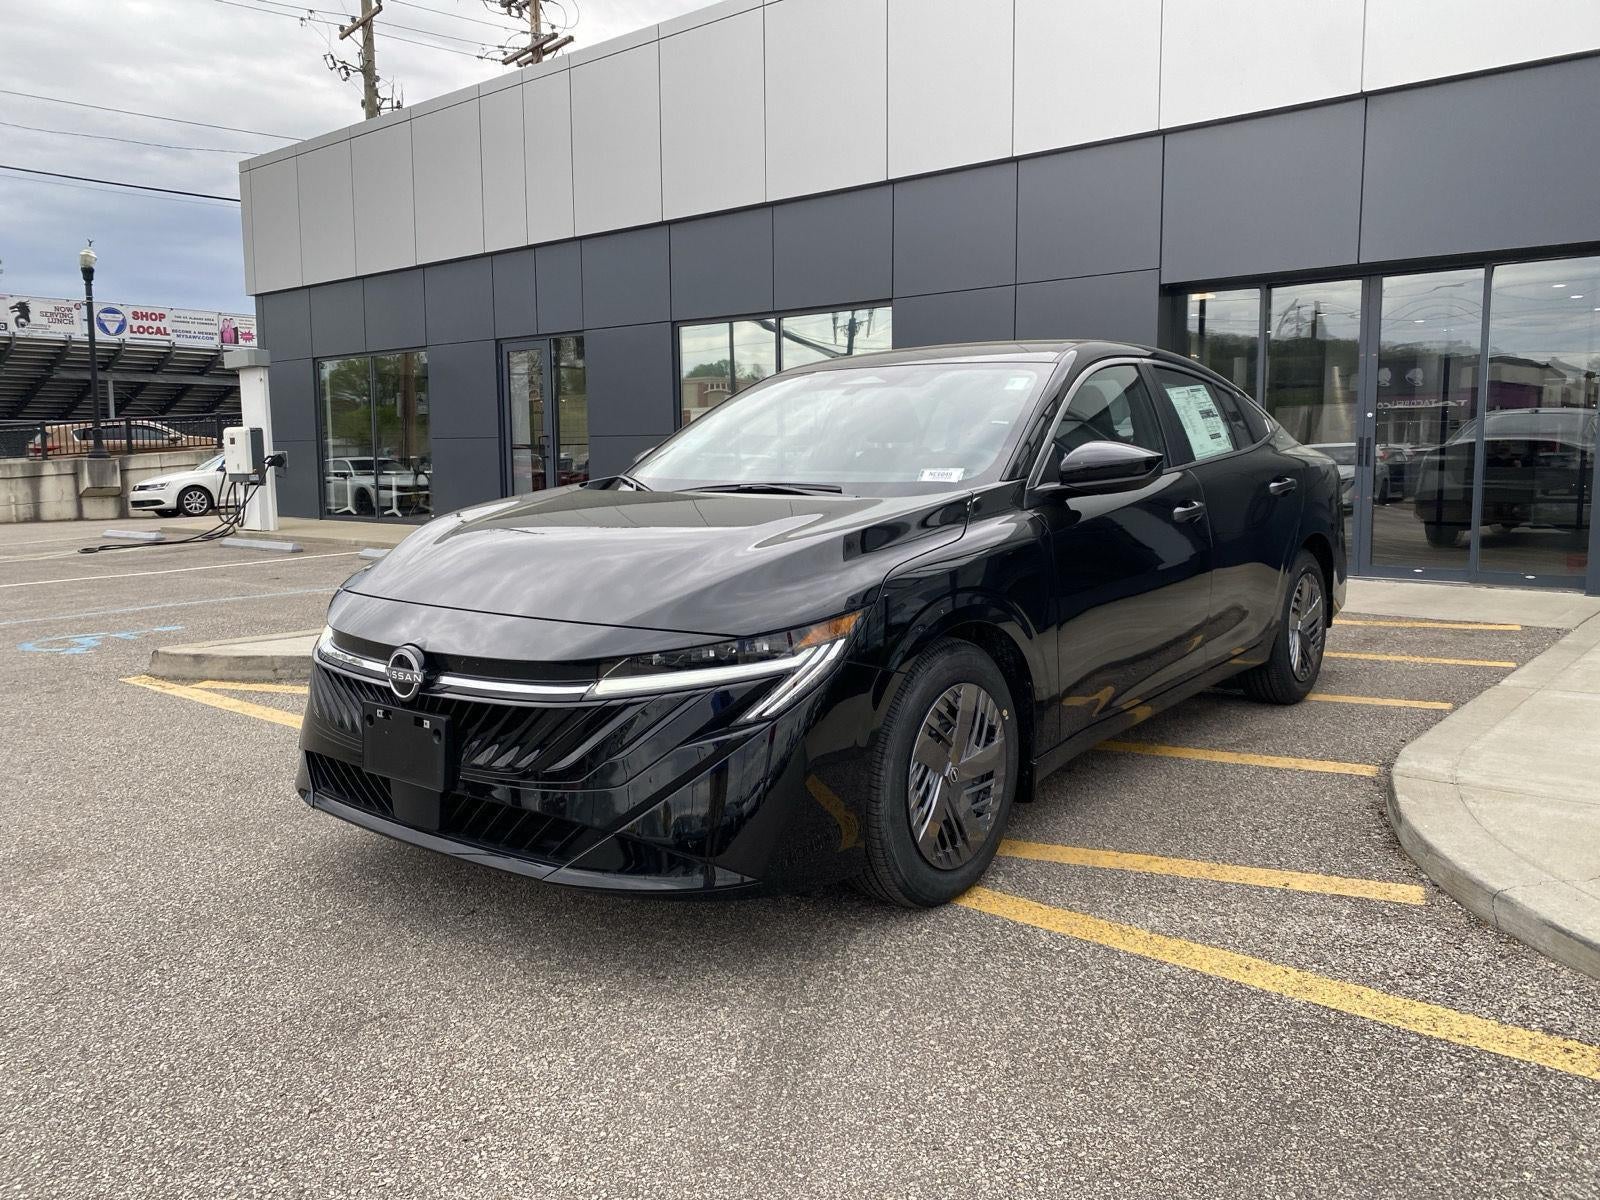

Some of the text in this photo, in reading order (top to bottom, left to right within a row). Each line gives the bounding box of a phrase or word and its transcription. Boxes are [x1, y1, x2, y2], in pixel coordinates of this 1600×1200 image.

[40, 311, 74, 319] SERVING
[54, 305, 73, 313] NOW
[131, 310, 166, 322] SHOP
[129, 324, 171, 336] LOCAL
[385, 668, 422, 683] NISSAN
